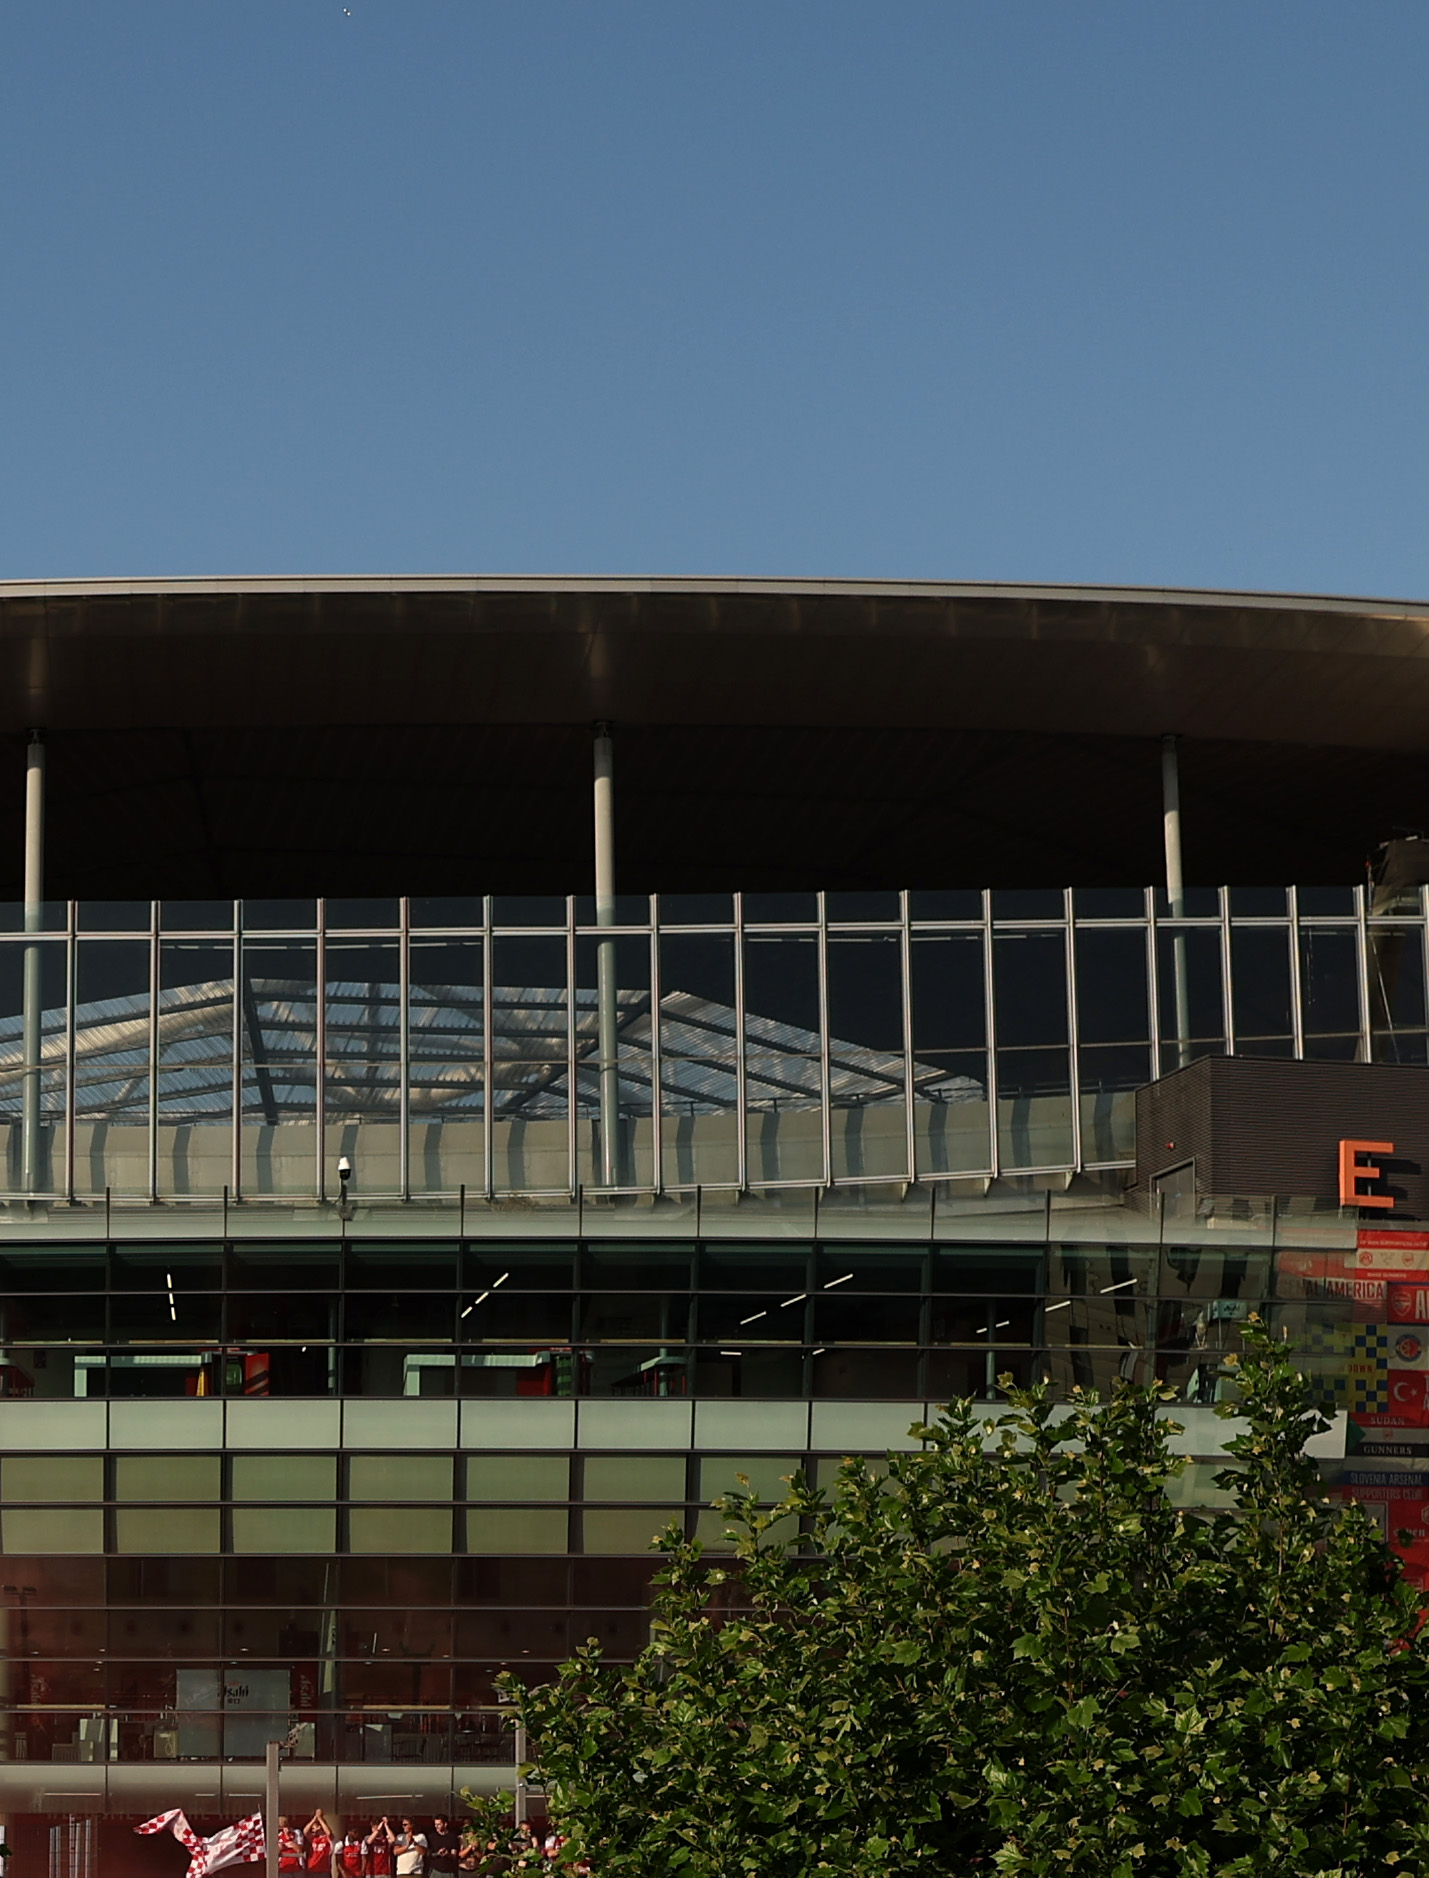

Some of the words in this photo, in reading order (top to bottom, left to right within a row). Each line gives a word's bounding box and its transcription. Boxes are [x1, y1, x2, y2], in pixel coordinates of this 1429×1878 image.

[1327, 1281, 1384, 1300] AMERICA
[1370, 1416, 1405, 1425] SUDAN
[1363, 1444, 1413, 1456] GUNNERS
[1350, 1472, 1387, 1485] SLOVENIA
[1389, 1473, 1423, 1486] ARSENAL
[1351, 1487, 1401, 1499] SUPPORTERS
[1402, 1488, 1423, 1499] CLUB
